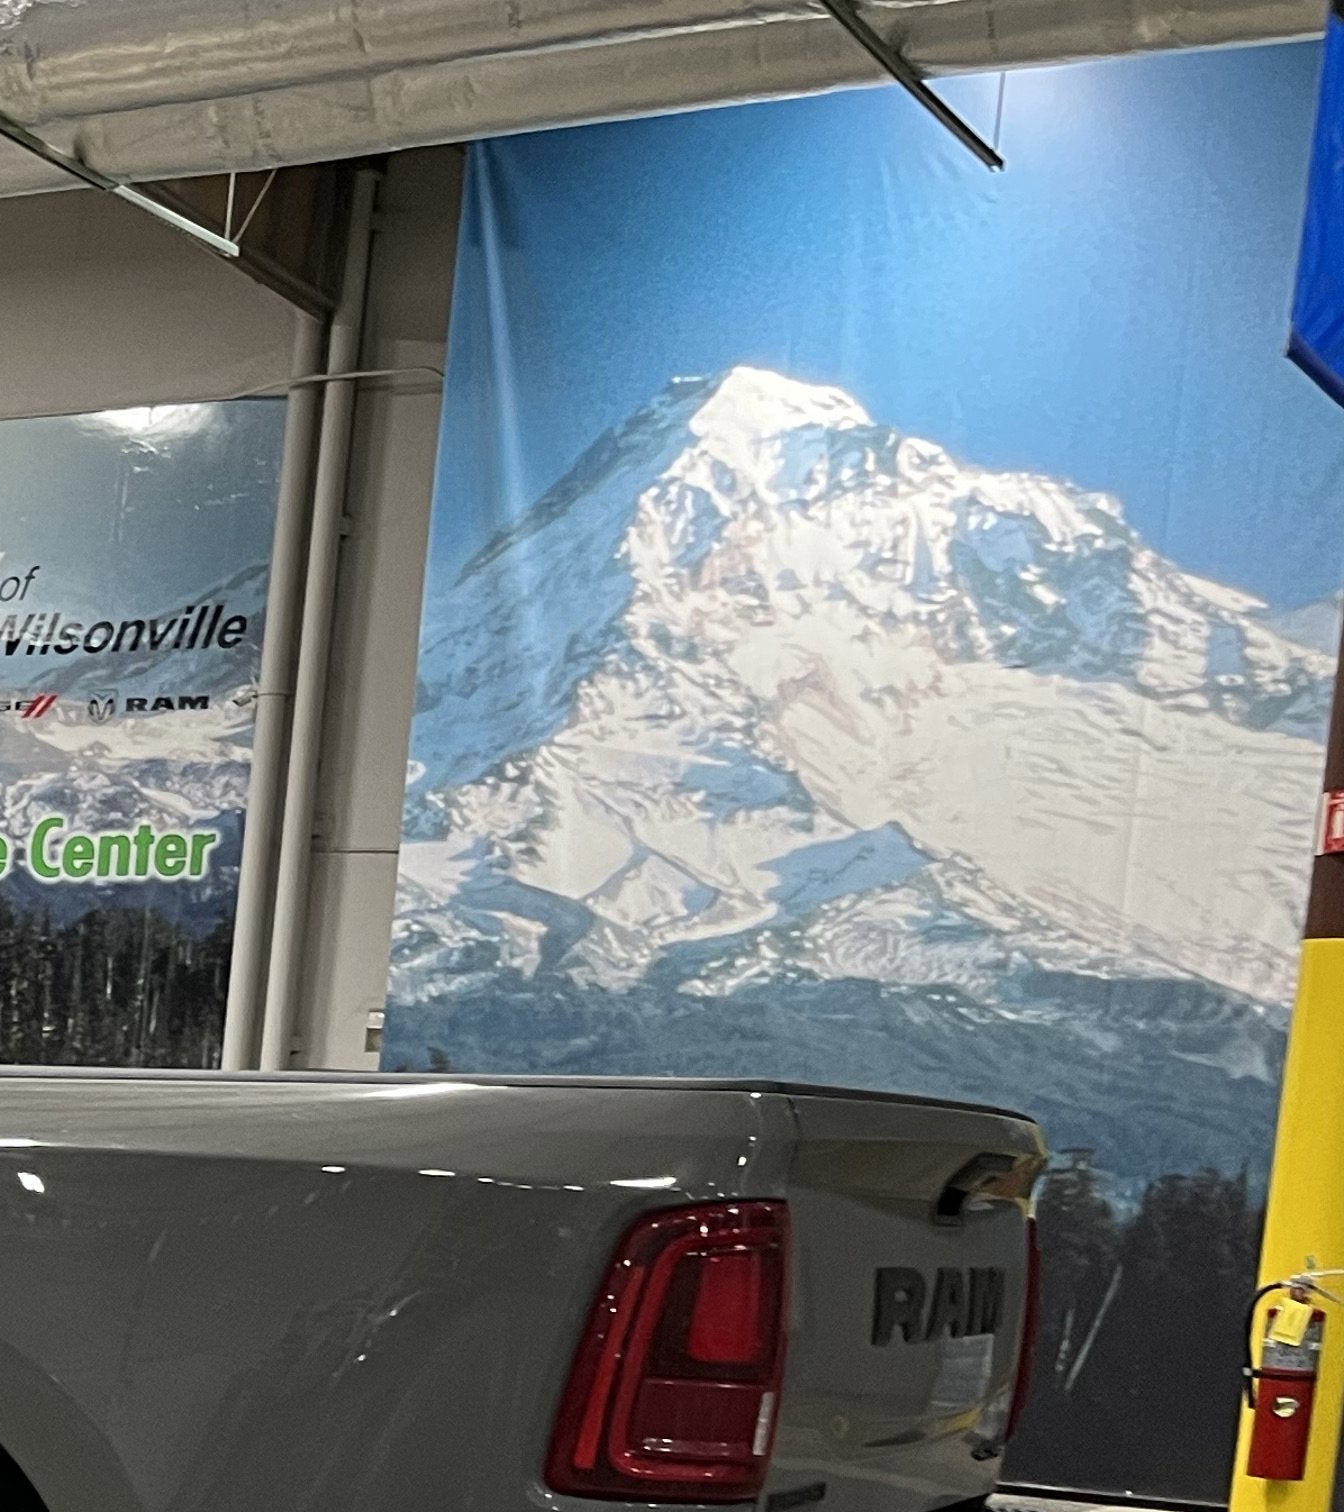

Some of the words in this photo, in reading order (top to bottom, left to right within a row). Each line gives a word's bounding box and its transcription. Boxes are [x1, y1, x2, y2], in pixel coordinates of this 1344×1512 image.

[125, 696, 210, 712] RAM
[30, 817, 216, 877] Center
[871, 1267, 1007, 1347] RAM
